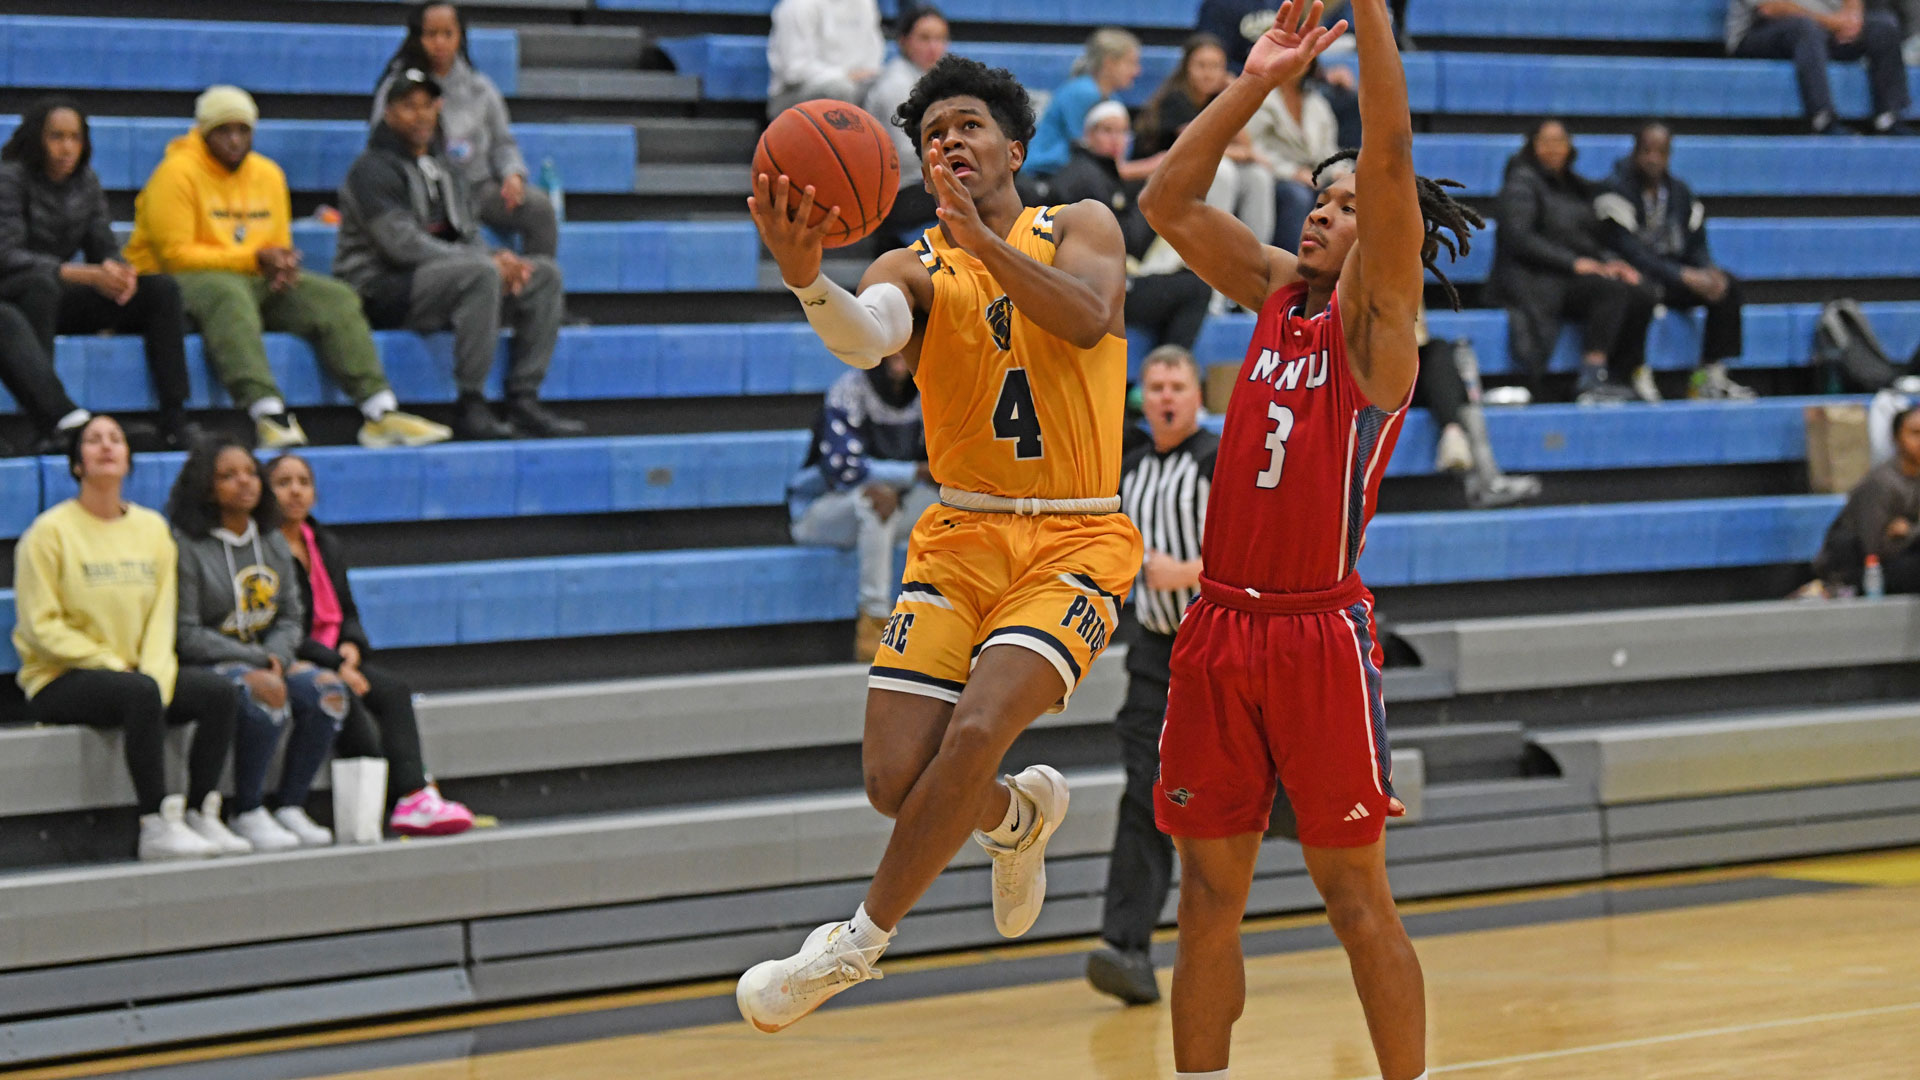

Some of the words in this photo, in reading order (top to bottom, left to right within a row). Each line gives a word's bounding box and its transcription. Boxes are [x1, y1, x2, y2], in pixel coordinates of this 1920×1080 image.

[991, 366, 1045, 461] 4
[1248, 347, 1328, 392] MNU
[1255, 400, 1294, 489] 3
